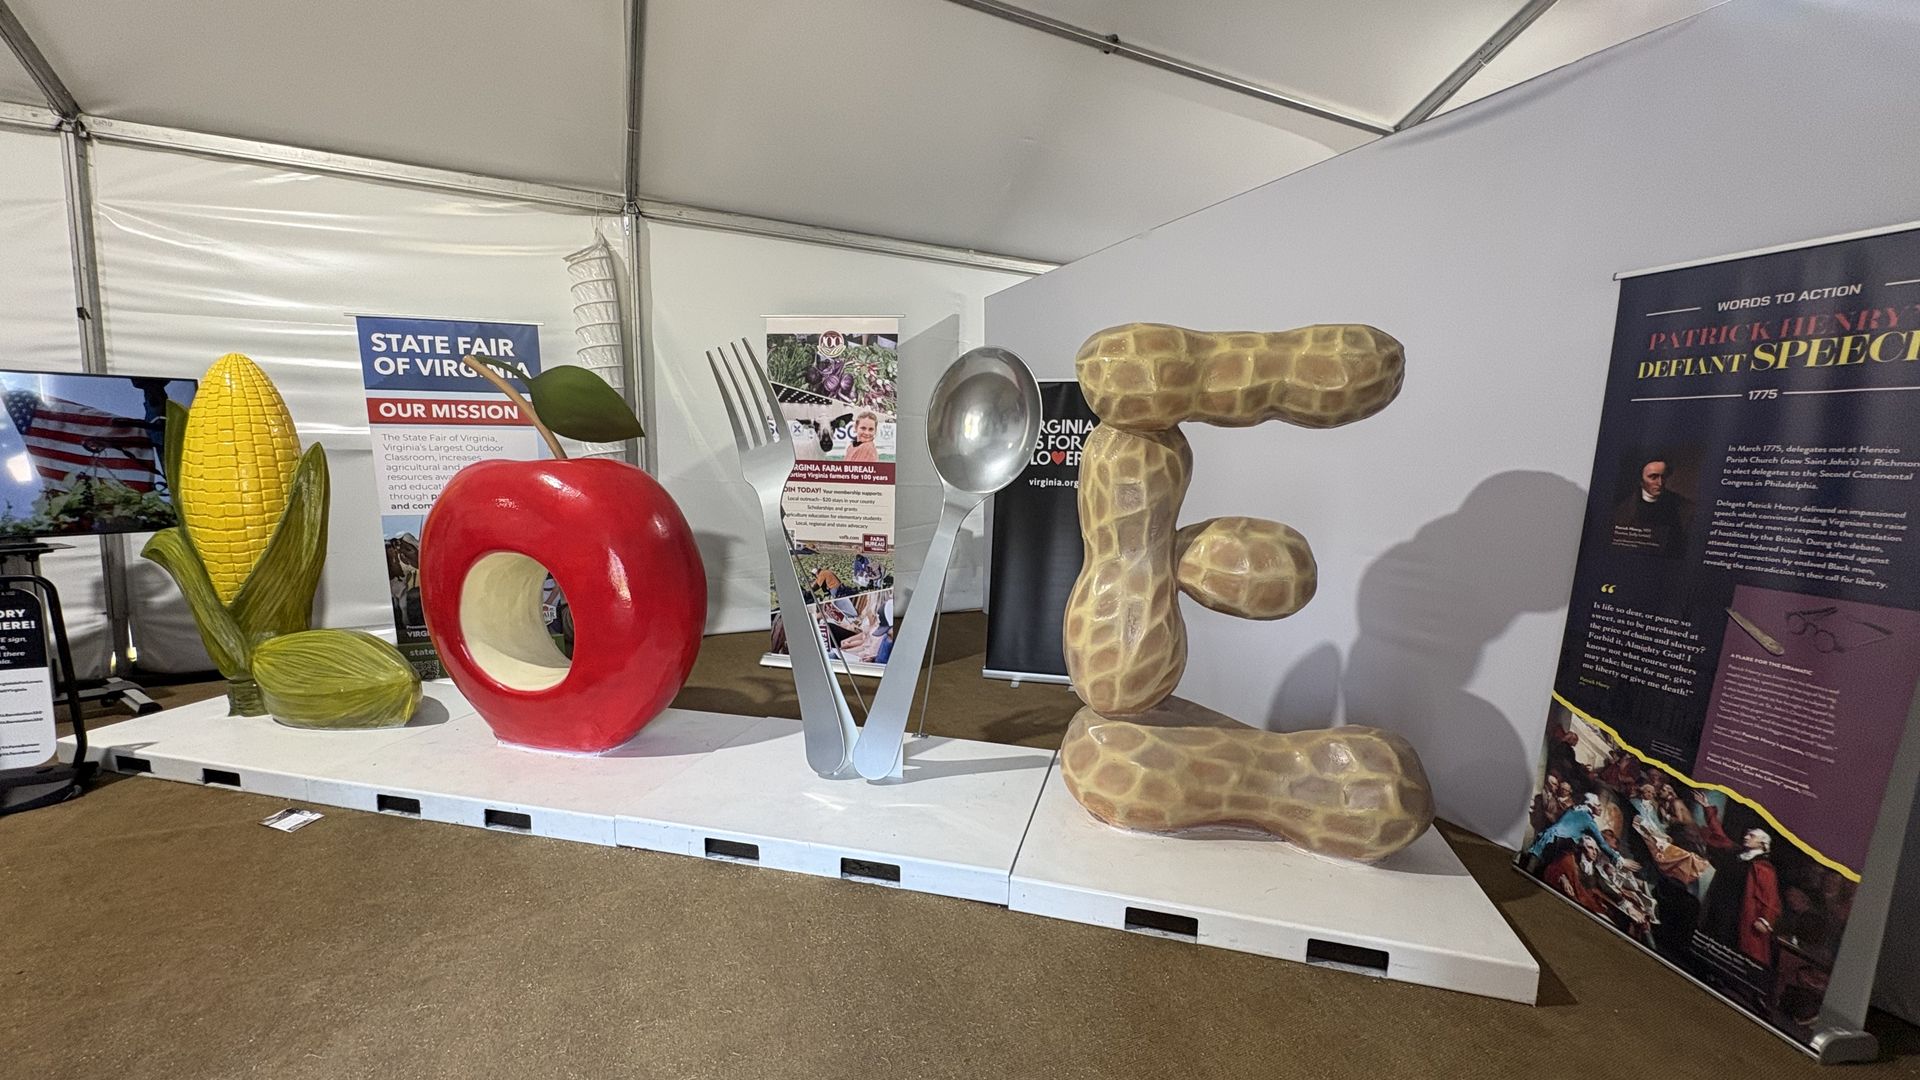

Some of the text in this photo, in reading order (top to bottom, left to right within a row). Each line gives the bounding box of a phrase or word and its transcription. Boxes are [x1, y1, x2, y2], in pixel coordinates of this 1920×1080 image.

[1718, 284, 1862, 311] WORDS TO ACTION
[1649, 321, 1770, 350] PATRICK
[371, 333, 515, 357] STATE FAIR
[374, 357, 532, 379] OF VIRGNIA
[1638, 354, 1747, 378] DEFIANT
[1748, 389, 1778, 400] 1775
[379, 402, 519, 420] OUR MISSION
[1040, 419, 1095, 434] RGINIA
[460, 435, 498, 443] Virginia,
[1036, 435, 1083, 450] S FOR
[383, 444, 427, 452] Virginia's
[429, 444, 464, 453] Largest
[384, 453, 437, 462] Classroom,
[1763, 445, 1784, 453] 1775,
[1786, 446, 1827, 455] delegates
[386, 464, 440, 472] agricultural
[1873, 458, 1920, 467] Richmon
[1029, 478, 1079, 488] virginia.org
[1751, 468, 1788, 477] delegates
[1852, 470, 1914, 480] Continental
[1721, 478, 1754, 488] Congress
[1764, 480, 1818, 490] Philadelphia.
[1716, 500, 1746, 509] Delegate
[1774, 503, 1800, 513] Henry
[1801, 506, 1837, 514] delivered
[1849, 509, 1907, 518] impassioned
[1703, 560, 1732, 569] revealing
[1745, 566, 1796, 576] contradiction
[1856, 578, 1888, 590] liberty.
[1602, 604, 1614, 612] life
[1626, 608, 1644, 618] dear,
[1655, 615, 1680, 625] peace
[1591, 613, 1615, 623] sweet,
[1636, 621, 1644, 629] be
[1646, 624, 1688, 638] purchased
[1588, 631, 1614, 644] Forbid
[1615, 637, 1623, 647] it,
[1625, 640, 1660, 656] Almighty
[1662, 649, 1685, 660] God!
[1602, 625, 1621, 635] price
[1630, 631, 1653, 641] chains
[1654, 638, 1670, 647] and
[1670, 640, 1706, 654] slavery?
[1586, 642, 1696, 675] know not what course others
[1582, 662, 1594, 670] me
[1595, 664, 1620, 678] liberty
[1629, 674, 1645, 684] give
[1647, 680, 1660, 688] me
[1584, 652, 1600, 662] may
[1602, 656, 1620, 667] take;
[1621, 660, 1632, 670] but
[1643, 666, 1655, 676] for
[1656, 672, 1672, 681] me,
[1674, 676, 1692, 686] give
